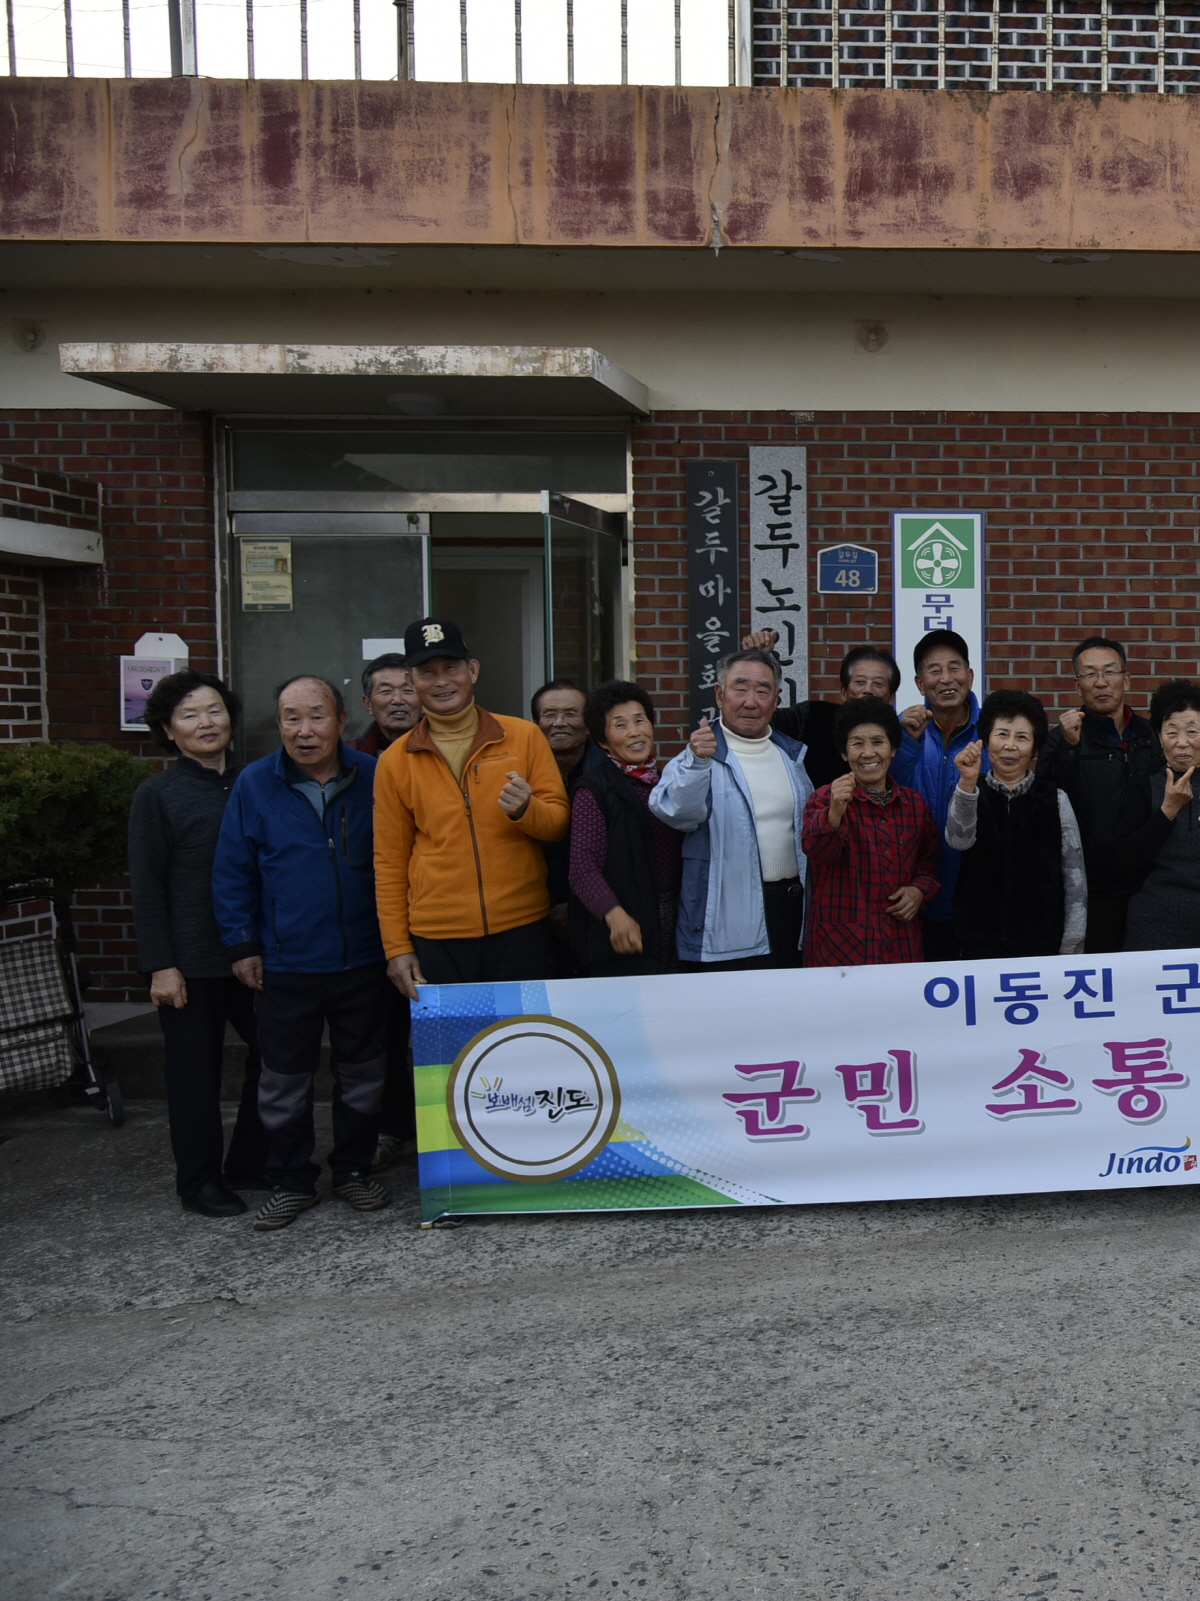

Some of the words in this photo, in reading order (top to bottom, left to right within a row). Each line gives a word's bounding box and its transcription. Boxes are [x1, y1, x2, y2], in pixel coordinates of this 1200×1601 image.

[834, 569, 861, 588] 48
[421, 623, 445, 647] B
[923, 968, 1116, 1026] 이동진
[722, 1048, 922, 1138] 군민
[985, 1037, 1187, 1121] 소통
[484, 1091, 534, 1113] 보배섬
[534, 1086, 595, 1120] 진도
[1098, 1152, 1181, 1178] Jindo
